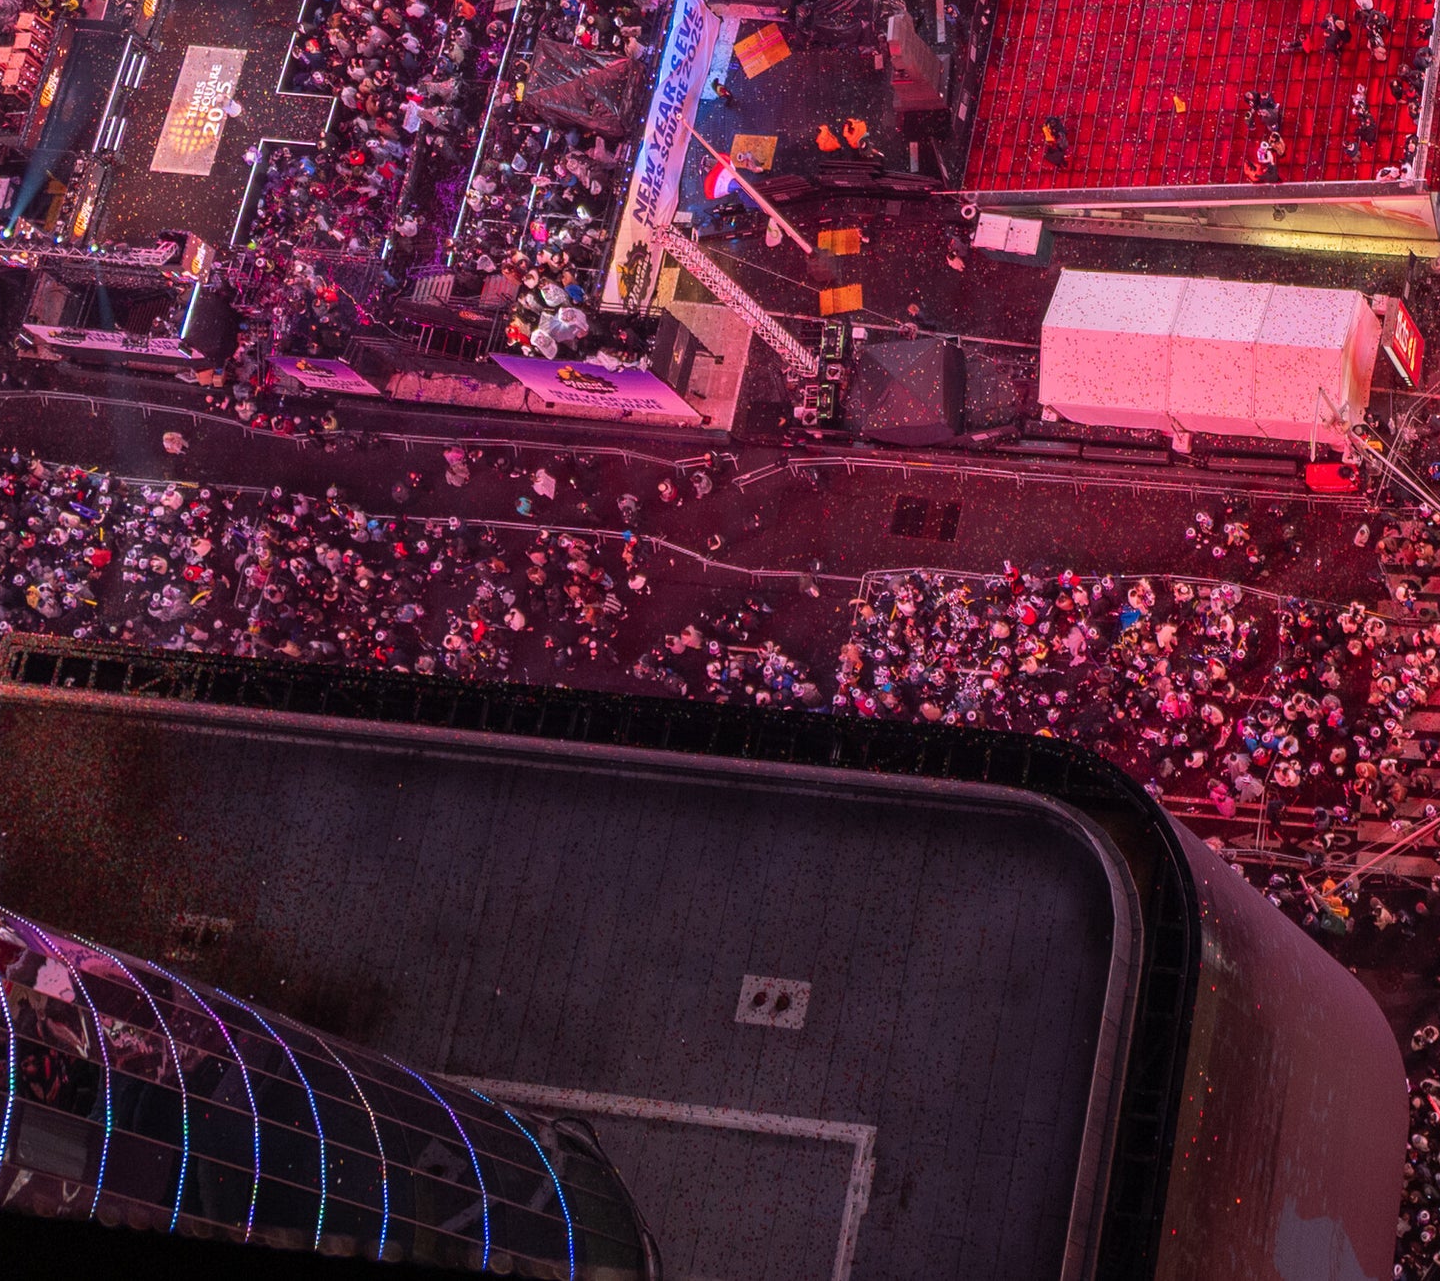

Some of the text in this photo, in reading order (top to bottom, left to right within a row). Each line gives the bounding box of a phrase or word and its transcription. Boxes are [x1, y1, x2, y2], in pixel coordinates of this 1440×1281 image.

[187, 81, 206, 119] TIMES
[199, 65, 223, 115] SQUARE
[632, 1, 698, 223] NEW YEAR'S EVE
[643, 14, 706, 233] TIMES SQUARE 2025
